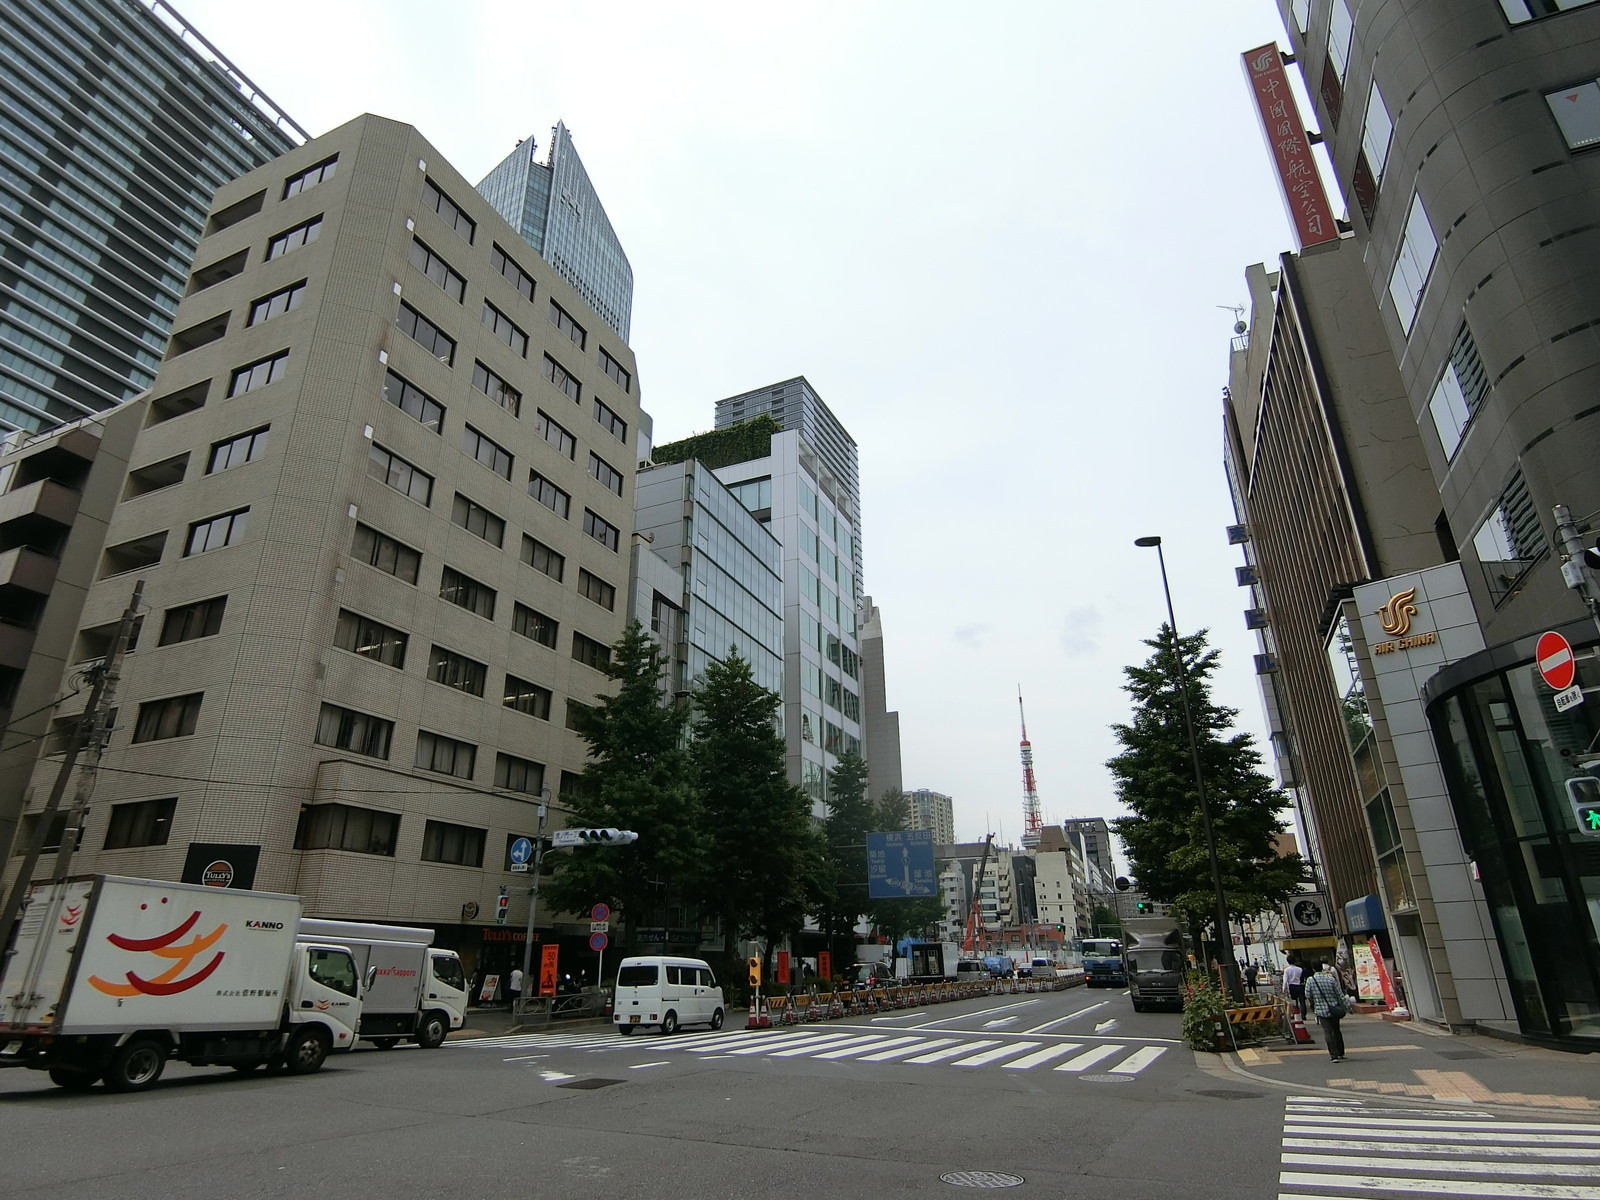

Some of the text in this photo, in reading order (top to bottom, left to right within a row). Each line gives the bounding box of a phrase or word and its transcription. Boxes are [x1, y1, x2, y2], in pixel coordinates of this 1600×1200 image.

[1374, 632, 1436, 656] AIR CHINA
[907, 831, 931, 841] 五反田
[246, 920, 284, 930] KANNO
[547, 951, 556, 961] 50
